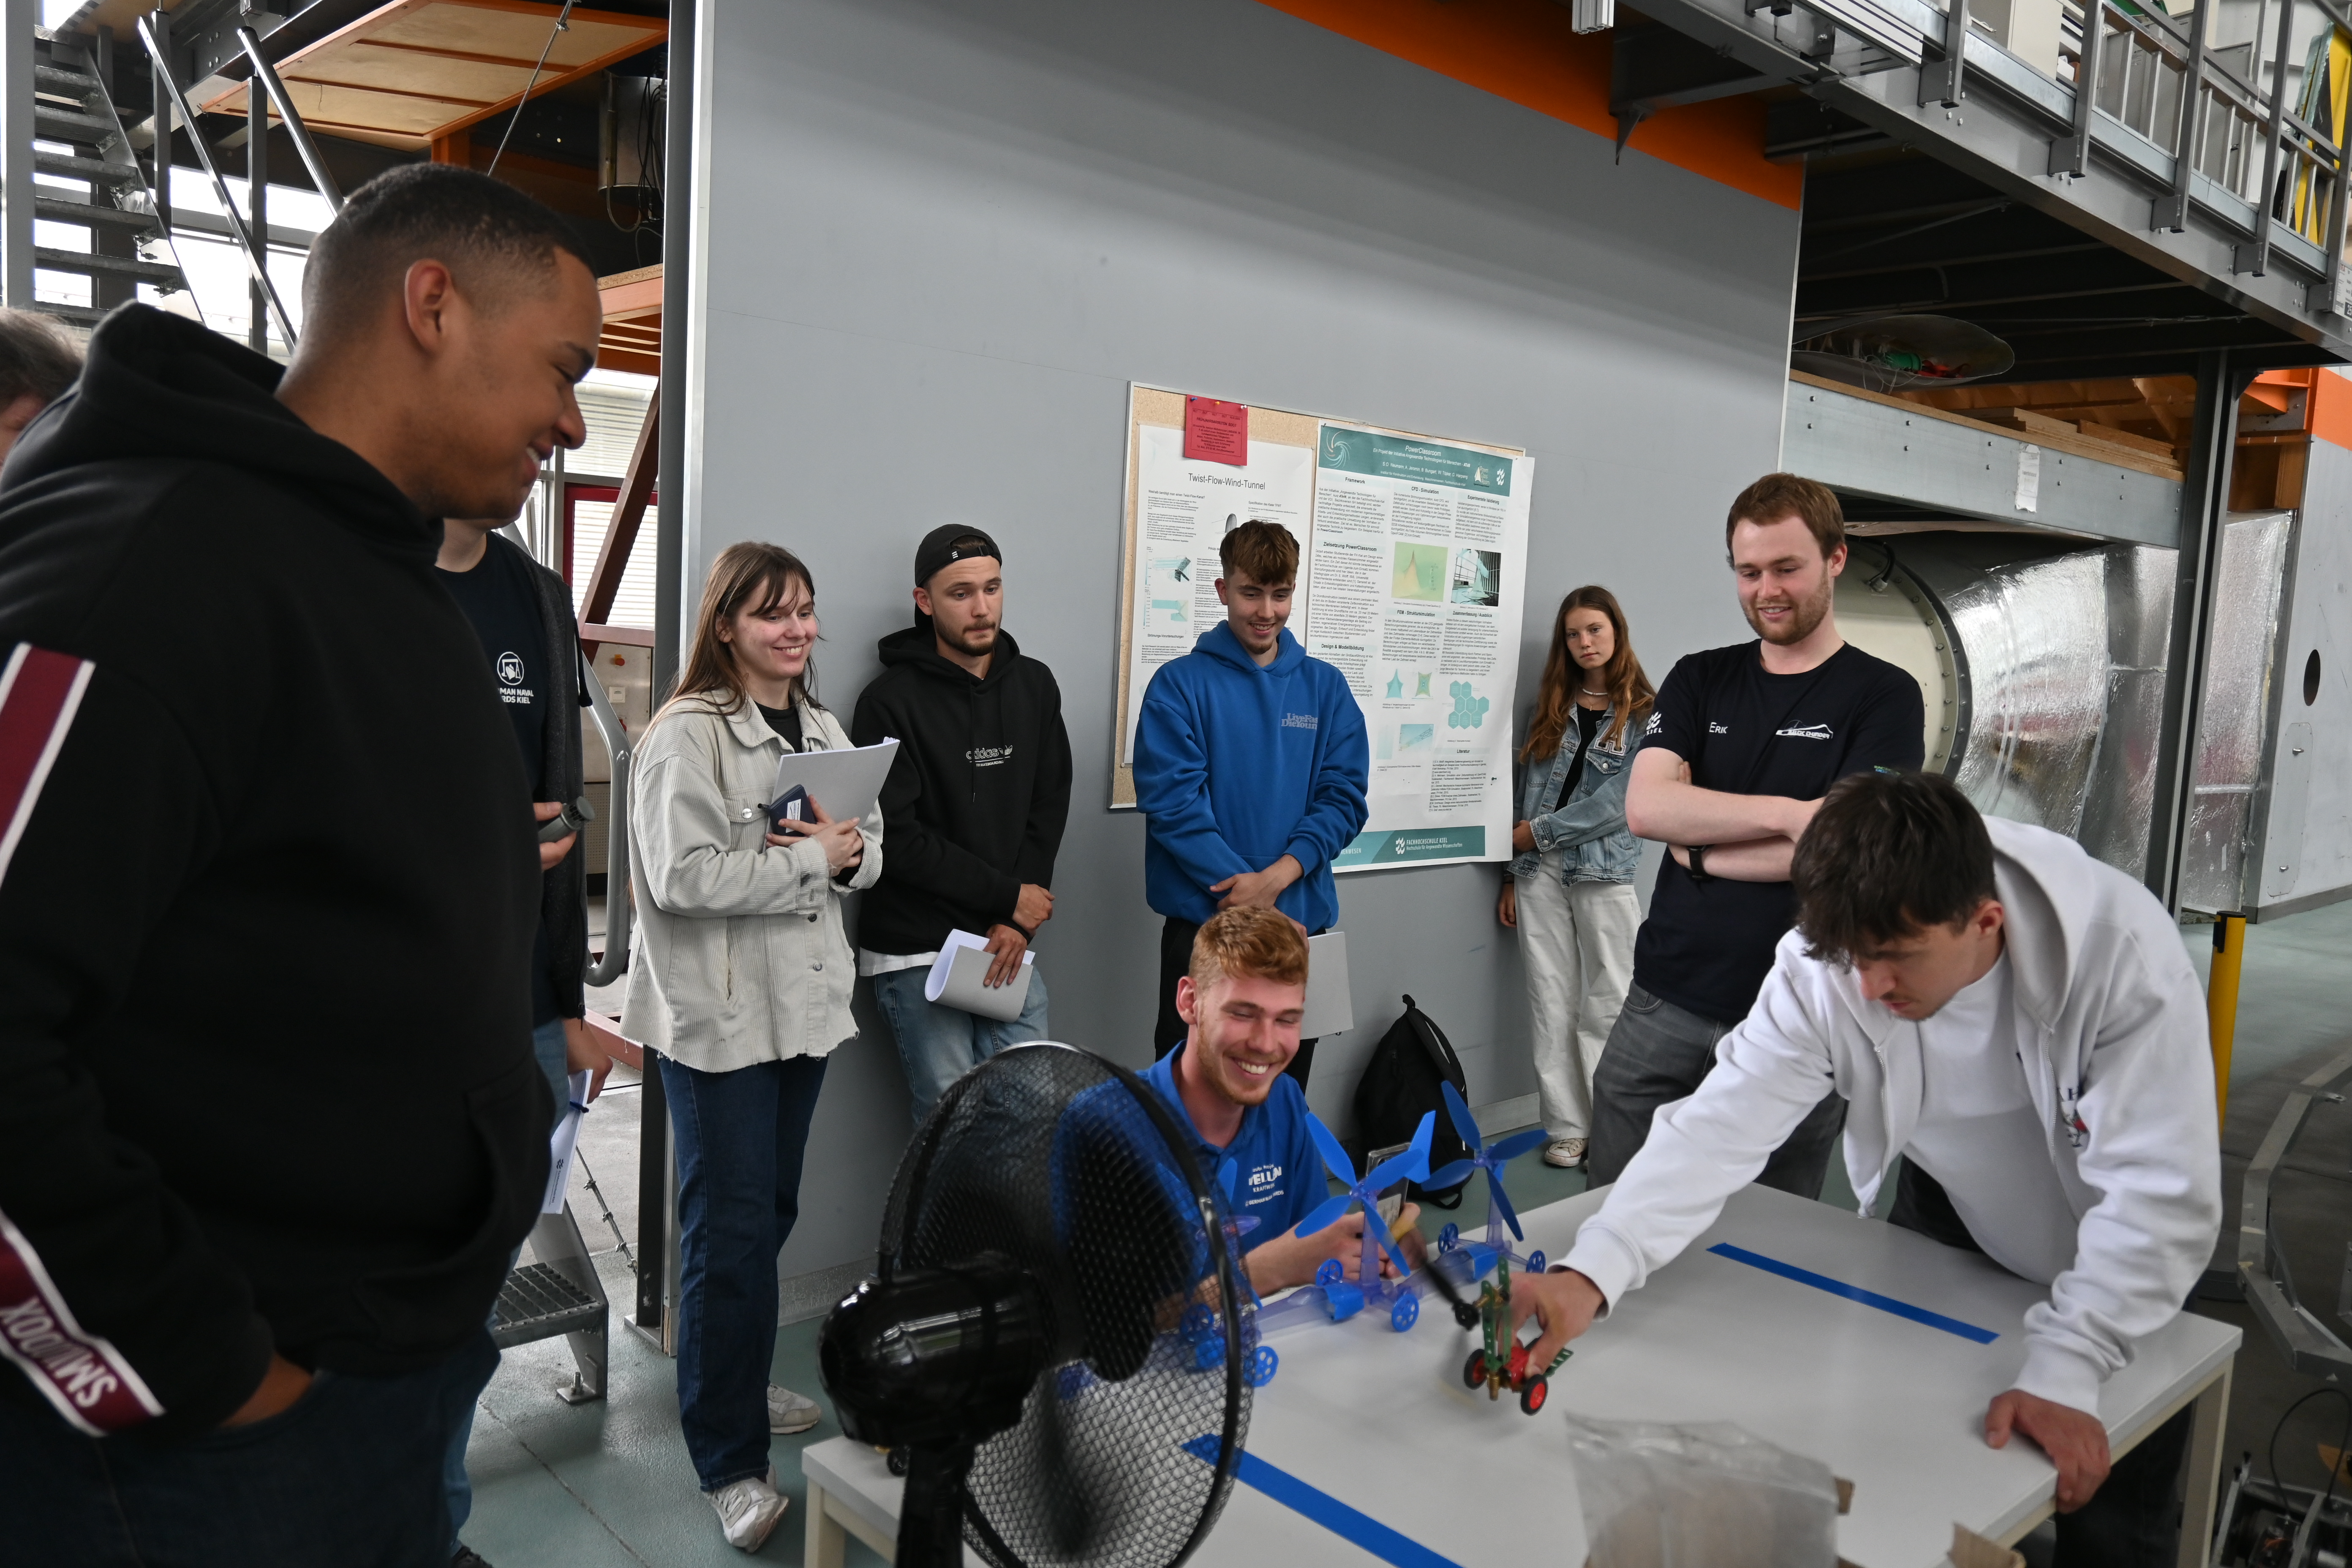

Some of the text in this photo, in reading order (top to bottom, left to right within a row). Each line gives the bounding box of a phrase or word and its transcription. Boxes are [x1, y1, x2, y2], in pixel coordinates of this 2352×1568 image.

[1405, 445, 1441, 457] PowerClassroom
[1188, 473, 1266, 490] Twist-Flow-Wind-Tunnel
[1287, 713, 1318, 723] LiveFas
[1281, 719, 1318, 730] DieYoun
